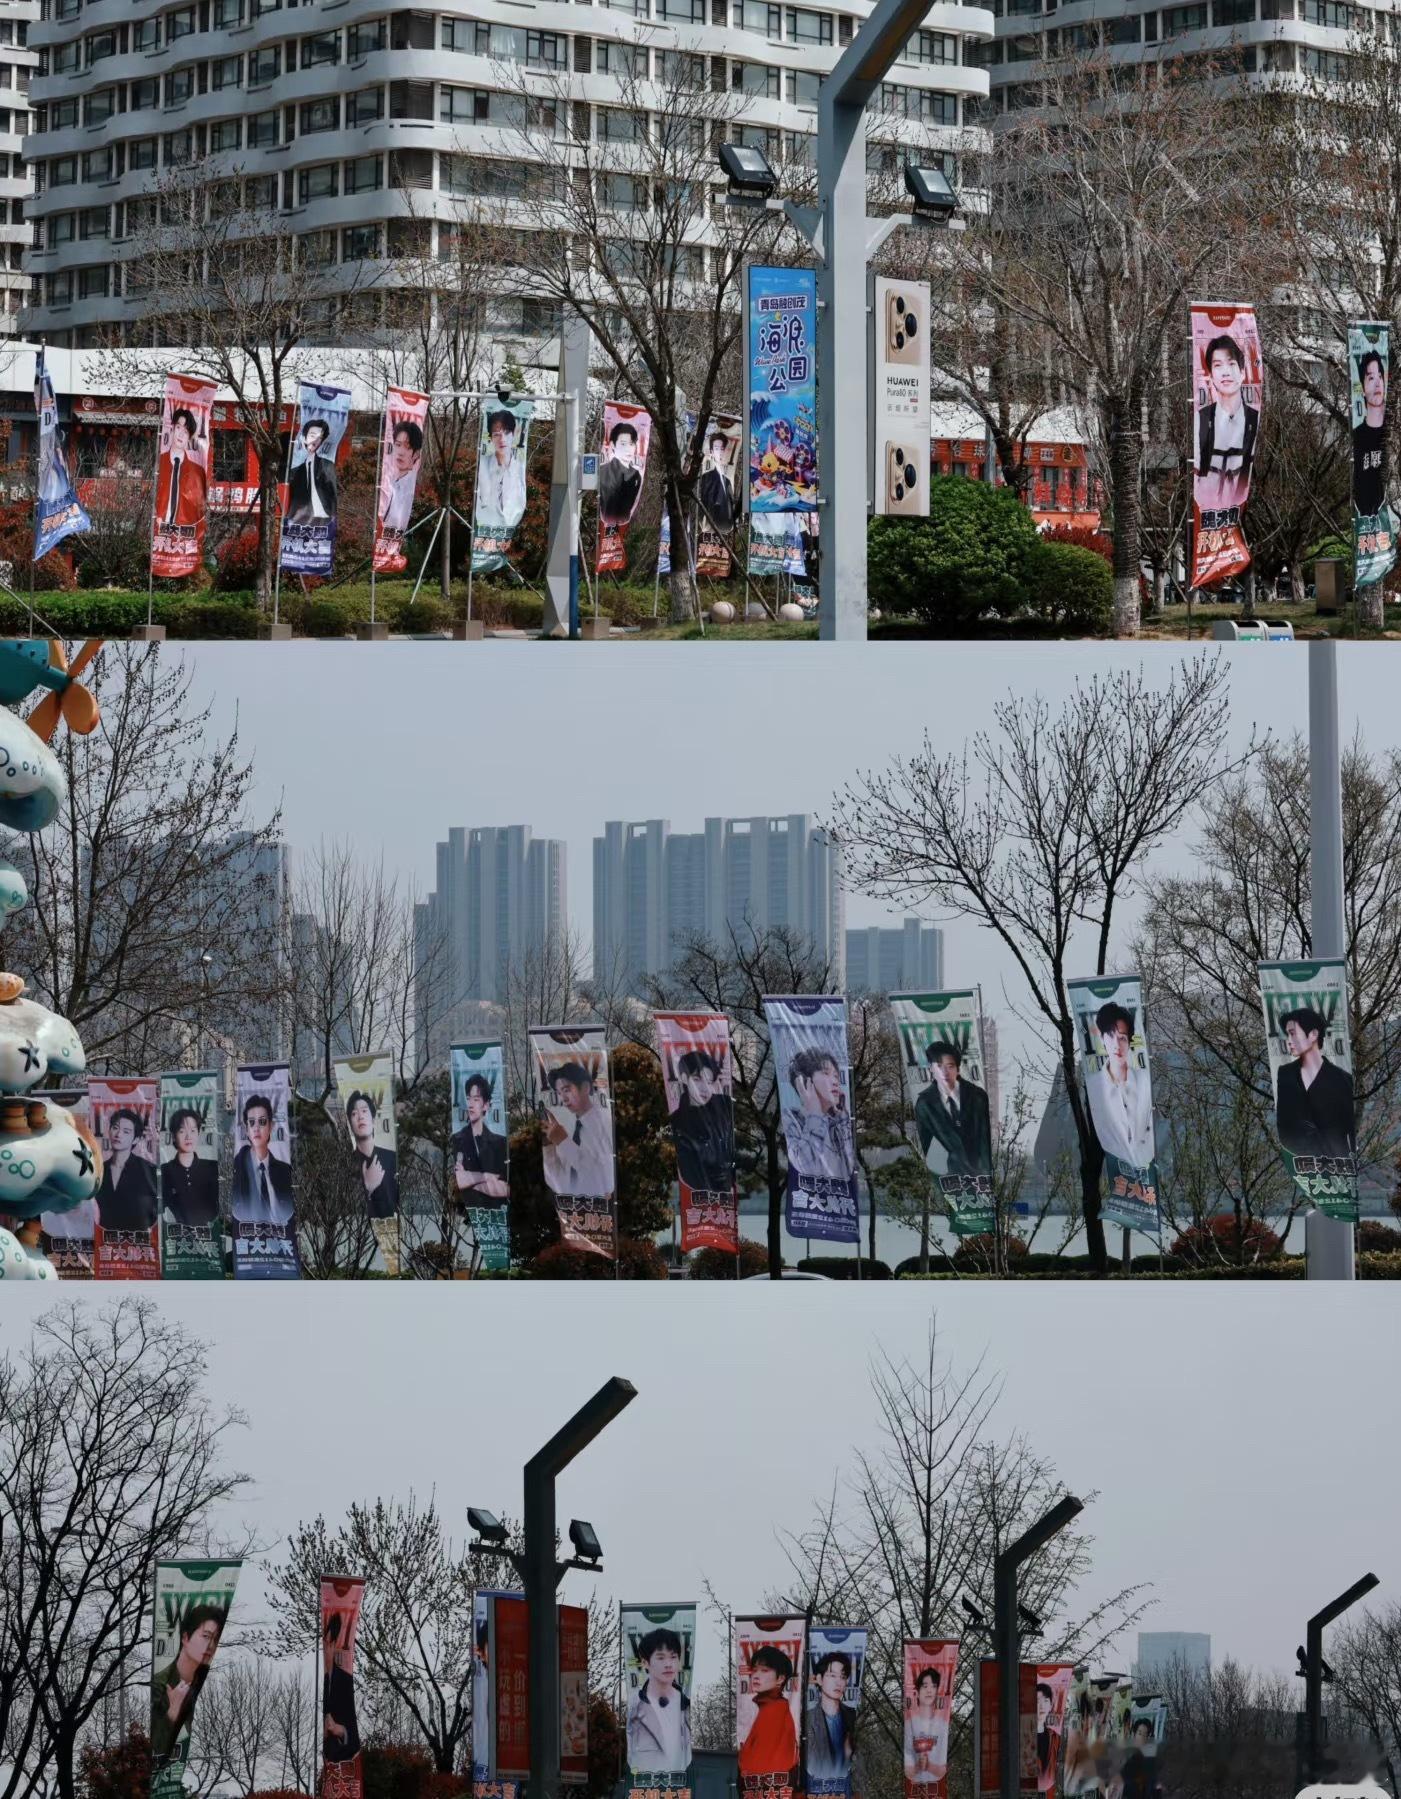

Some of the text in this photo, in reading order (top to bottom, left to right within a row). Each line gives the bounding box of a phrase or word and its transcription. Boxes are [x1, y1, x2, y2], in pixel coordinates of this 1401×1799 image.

[760, 296, 805, 310] 青岛融创茂
[887, 376, 919, 387] HUAWEI
